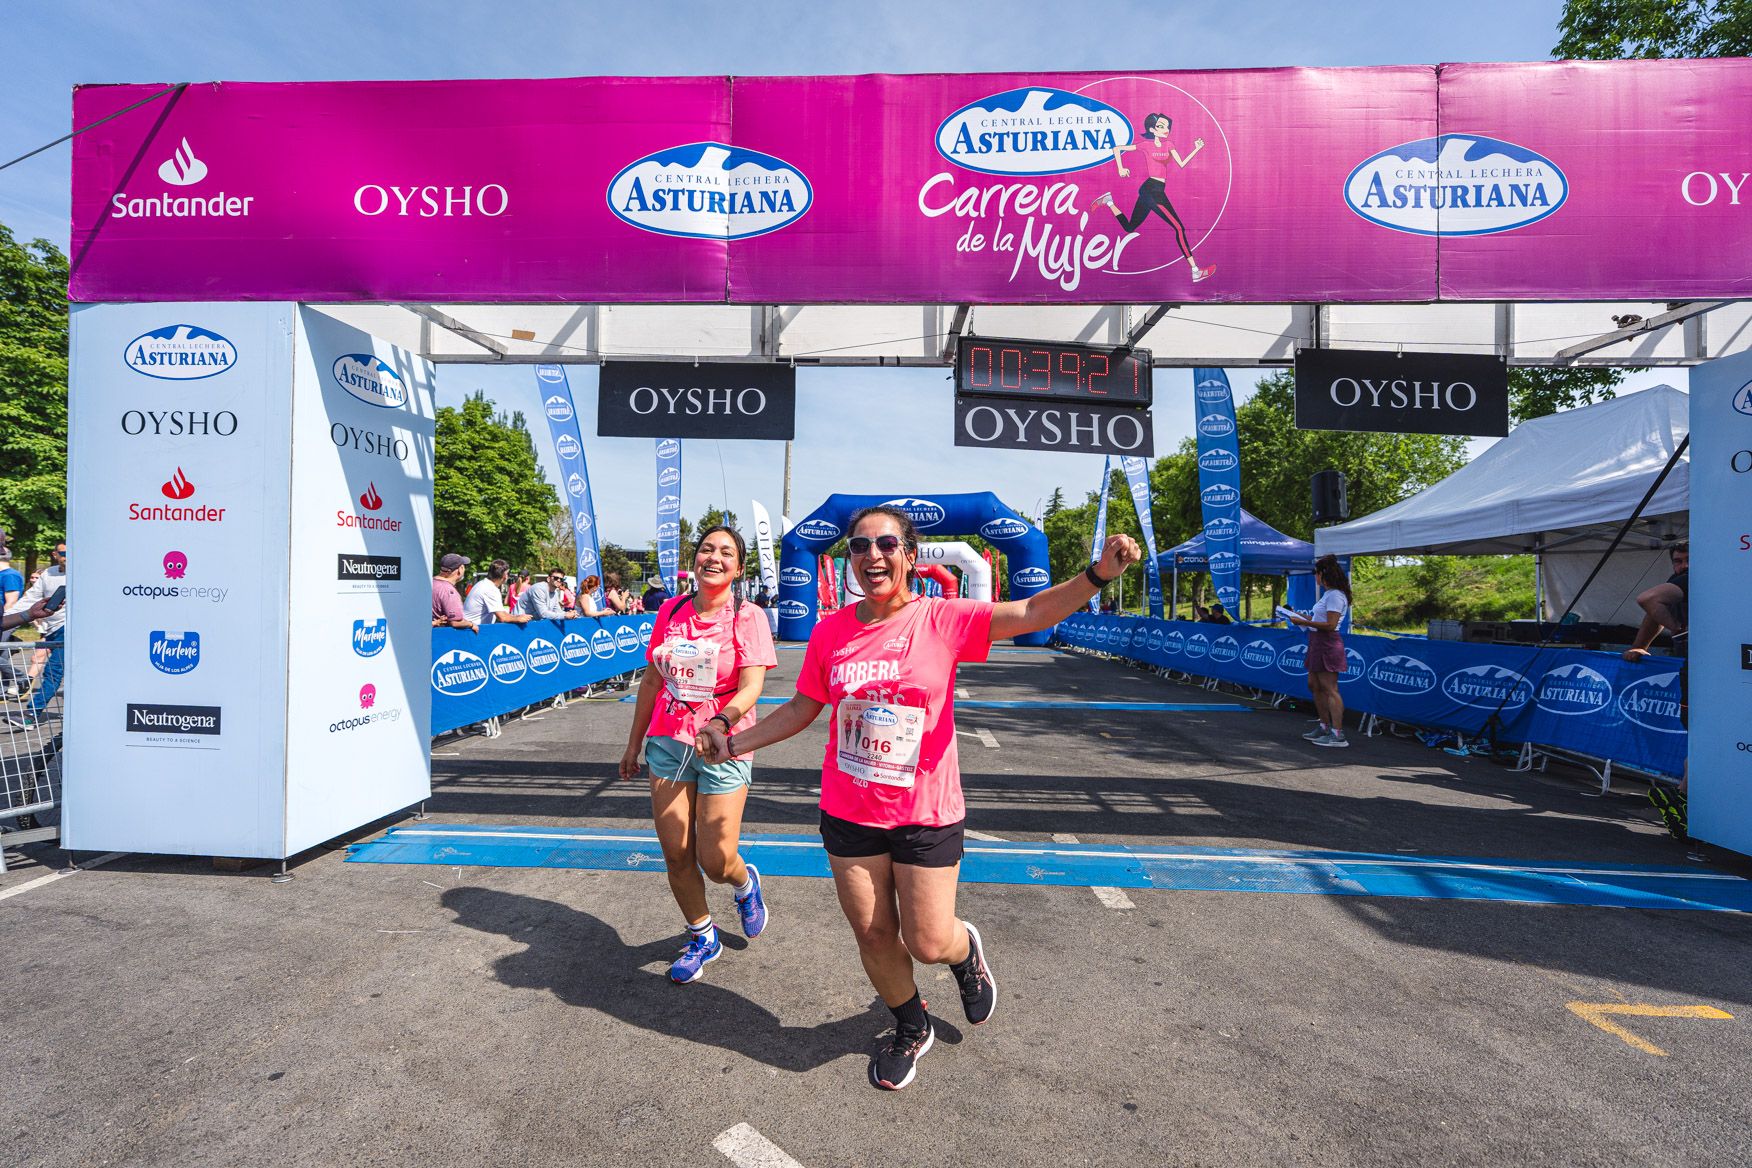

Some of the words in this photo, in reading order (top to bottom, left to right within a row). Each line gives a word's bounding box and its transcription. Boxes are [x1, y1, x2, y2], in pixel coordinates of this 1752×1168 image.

[981, 117, 1044, 128] CENTRAL
[1048, 115, 1112, 125] LECHERA
[950, 121, 1118, 155] ASTURIANA
[655, 174, 720, 186] CENTRAL
[727, 174, 791, 186] LECHERA
[1395, 168, 1451, 179] CENTRAL
[1470, 167, 1544, 178] LECHERA
[354, 184, 509, 218] OYSHO
[622, 177, 797, 215] ASTURIANA
[918, 172, 1077, 219] Carrera
[1361, 170, 1550, 210] ASTURIANA
[111, 192, 254, 218] Santander
[956, 230, 986, 253] de
[993, 221, 1015, 253] la
[1008, 215, 1141, 292] Mujer
[132, 344, 229, 367] ASTURIANA
[971, 346, 1138, 395] 00:39:21
[339, 362, 403, 402] ASTURIANA
[629, 387, 766, 416] OYSHO
[1329, 377, 1477, 412] OYSHO
[121, 410, 238, 436] OYSHO
[965, 405, 1144, 450] OYSHO
[330, 422, 409, 461] OYSHO
[129, 503, 226, 522] Santander
[337, 510, 402, 532] Santander
[908, 512, 940, 522] RIANA
[798, 525, 837, 536] ASTURIANA
[985, 526, 1026, 536] ASTURIANA
[342, 559, 398, 578] Neutrogena
[1015, 574, 1048, 583] ASTURIANA
[122, 584, 179, 600] octopus
[180, 587, 229, 603] energy
[354, 626, 386, 648] Marlene
[152, 640, 198, 663] Marlene
[529, 652, 558, 668] ASTURIANA
[1242, 649, 1272, 664] ASTURIANA
[1280, 654, 1304, 668] ASTURI
[436, 667, 487, 689] ASTURIANA
[492, 659, 525, 676] ASTURIANA
[670, 666, 695, 678] 016
[1370, 665, 1429, 689] ASTURIANA
[1448, 677, 1526, 703] ASTURIANA
[1540, 686, 1603, 706] ASTURIANA
[132, 709, 216, 731] Neutrogena
[329, 714, 371, 733] octopus
[370, 707, 402, 723] energy
[865, 712, 896, 724] ASTURIANA
[862, 736, 892, 753] 016
[867, 753, 883, 761] 2240
[880, 774, 905, 782] Santander
